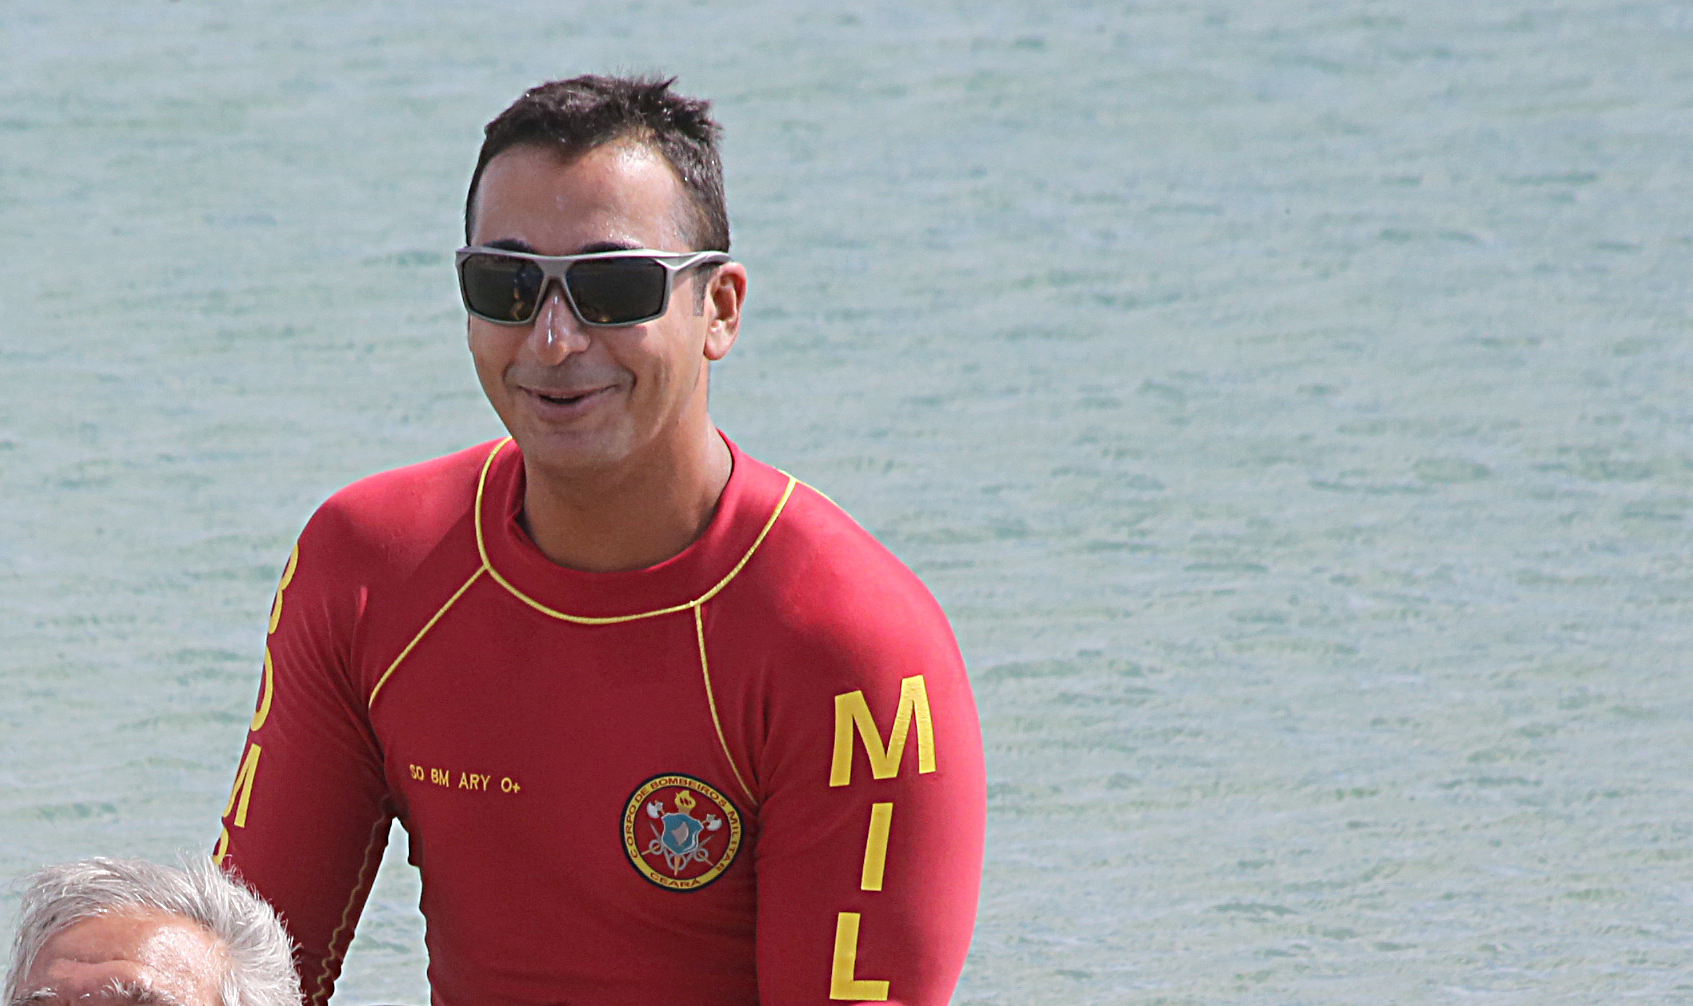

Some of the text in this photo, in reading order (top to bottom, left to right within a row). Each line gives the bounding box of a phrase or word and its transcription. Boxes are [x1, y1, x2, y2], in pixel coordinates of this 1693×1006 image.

[430, 768, 450, 788] BM
[458, 772, 491, 792] ARY
[625, 777, 739, 872] CORPO DE BOMBEIROS MILITAR
